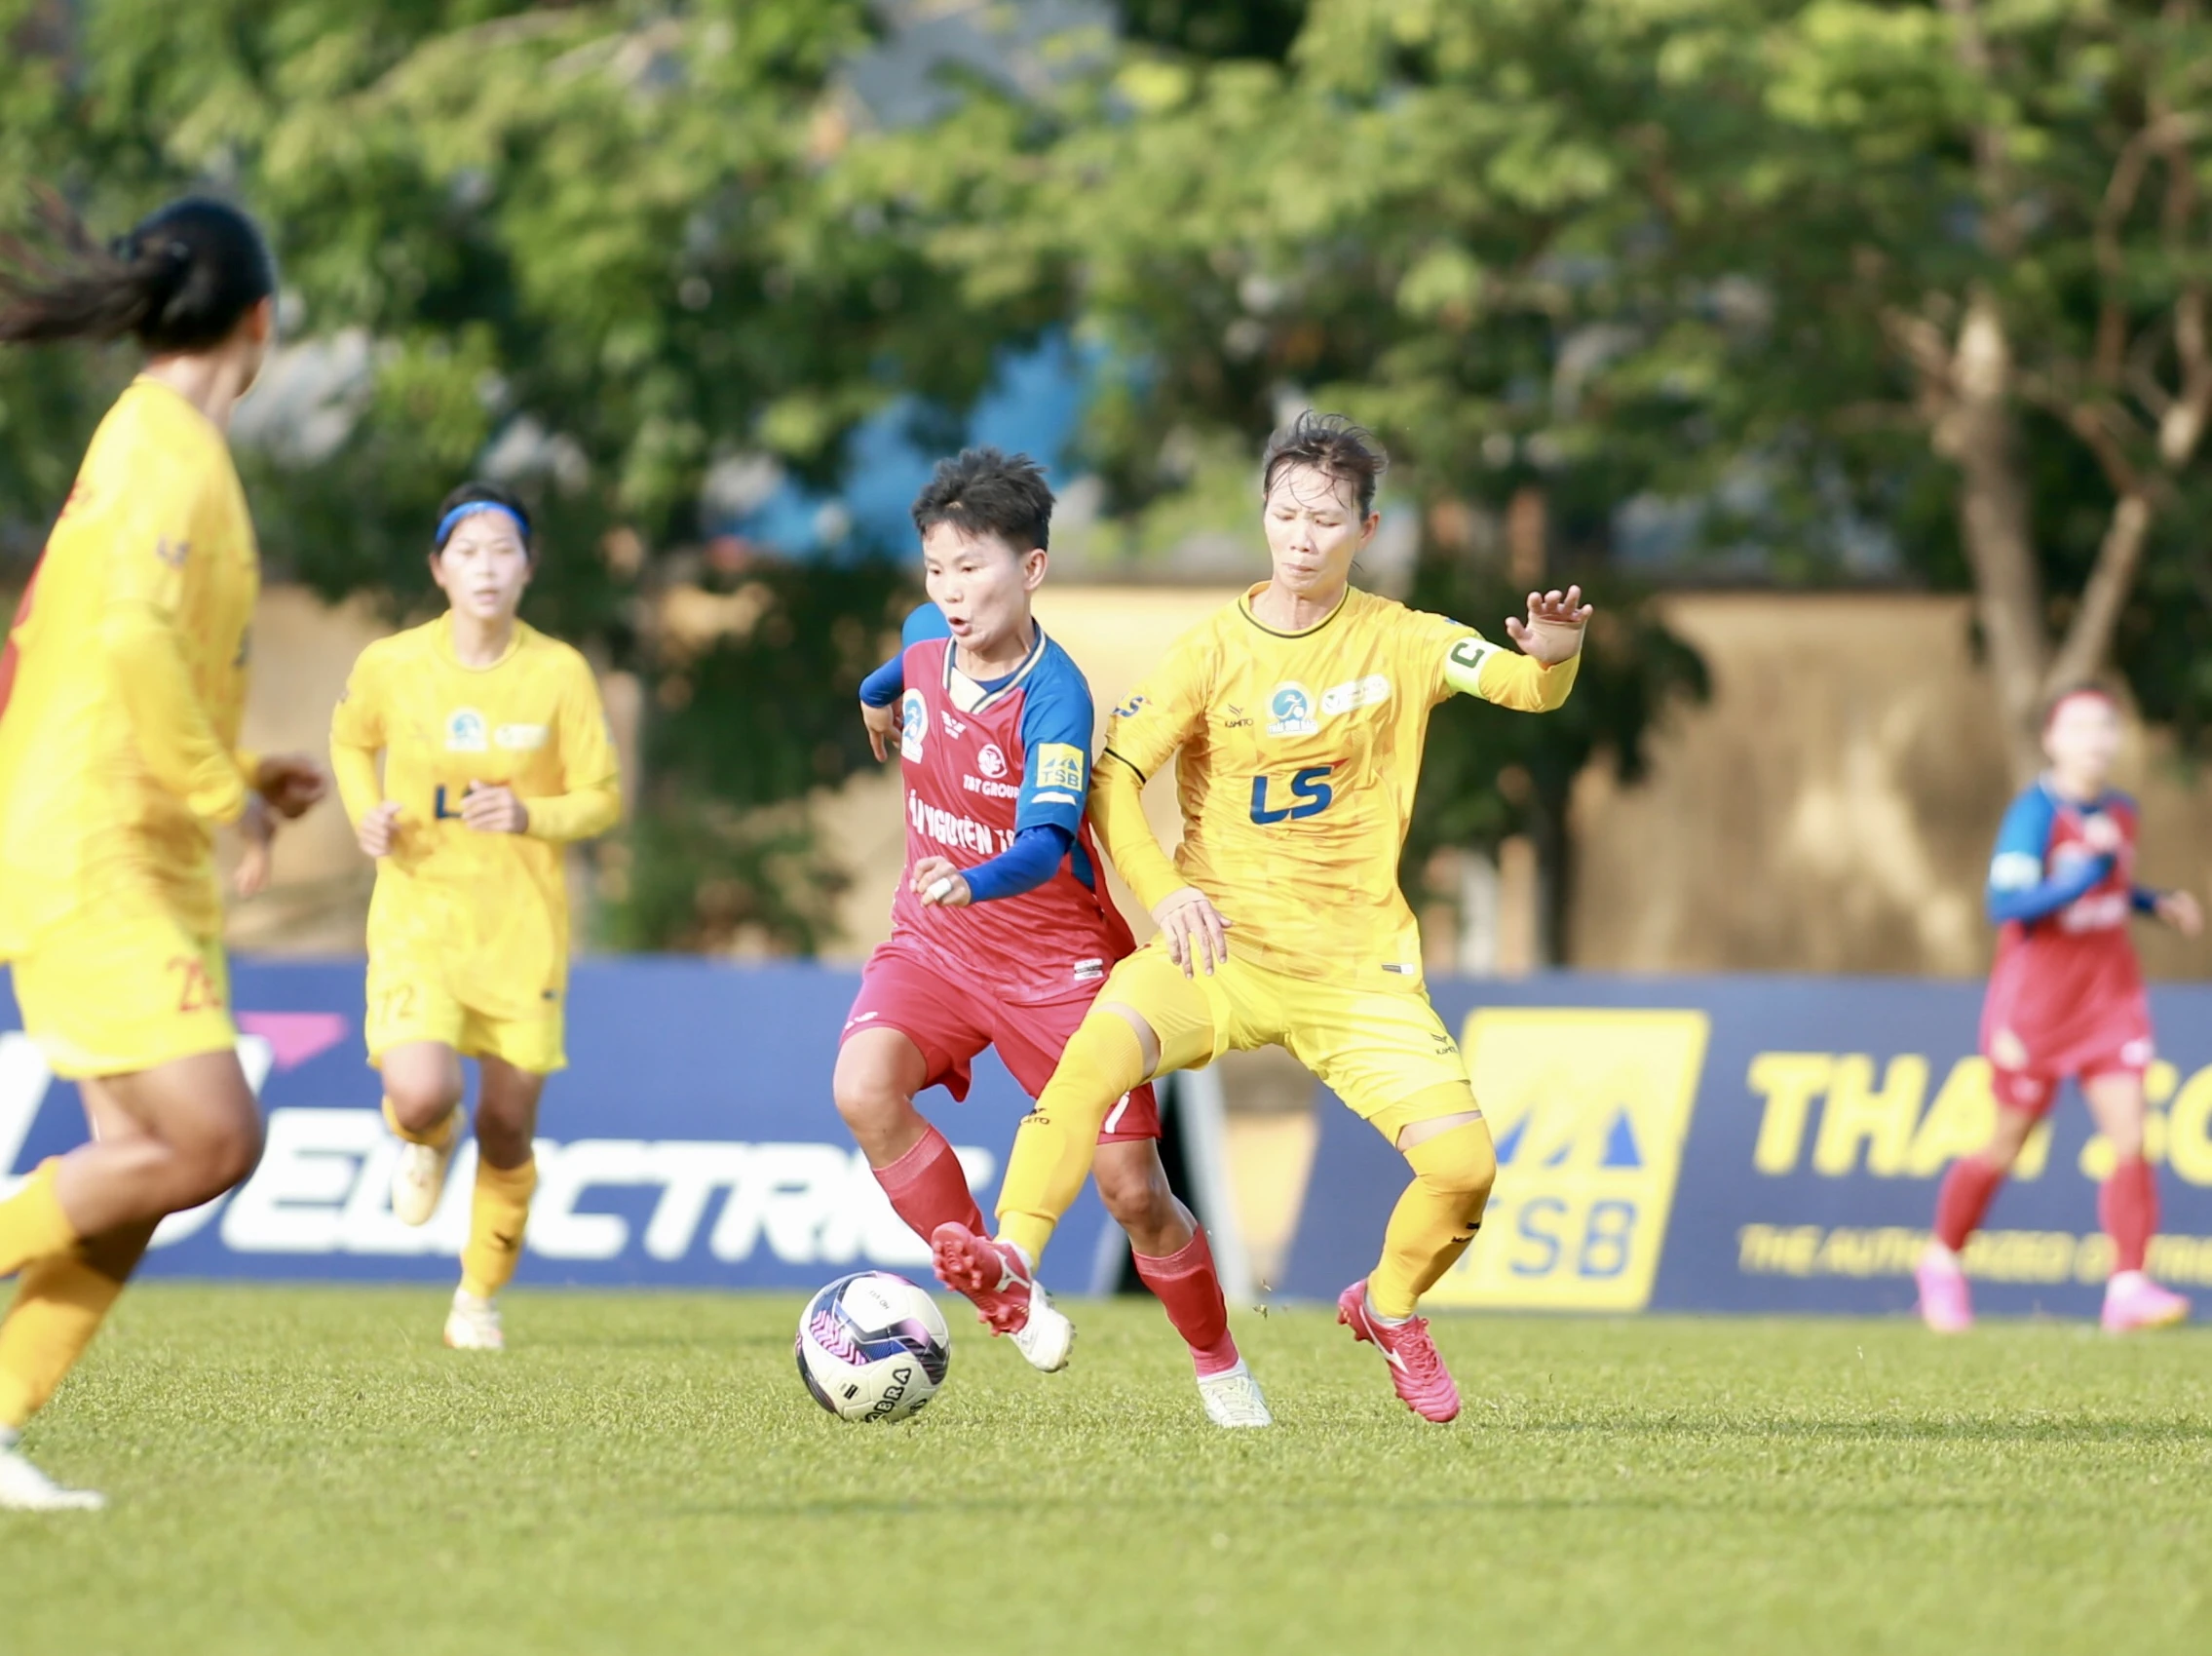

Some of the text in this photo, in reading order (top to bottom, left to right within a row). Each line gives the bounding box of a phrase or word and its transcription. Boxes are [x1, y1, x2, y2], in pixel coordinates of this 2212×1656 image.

[1450, 641, 1486, 669] C
[1040, 769, 1080, 788] TSB
[1249, 765, 1335, 826] LS
